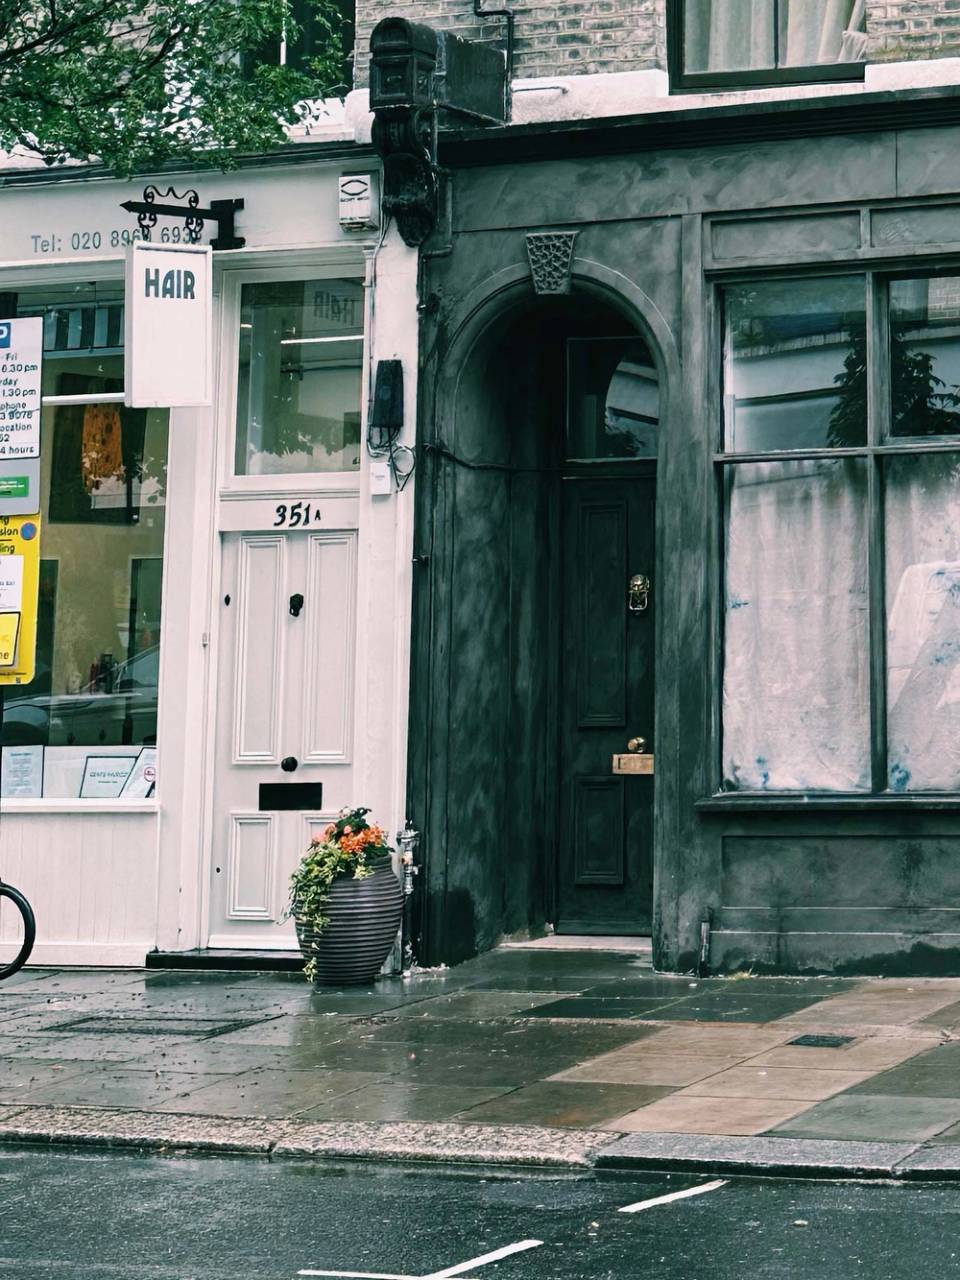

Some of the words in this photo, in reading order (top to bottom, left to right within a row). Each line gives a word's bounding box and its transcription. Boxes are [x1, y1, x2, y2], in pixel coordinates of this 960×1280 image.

[31, 233, 62, 253] Tel:
[71, 231, 102, 250] 020
[145, 268, 195, 300] HAIR
[9, 446, 34, 454] hours
